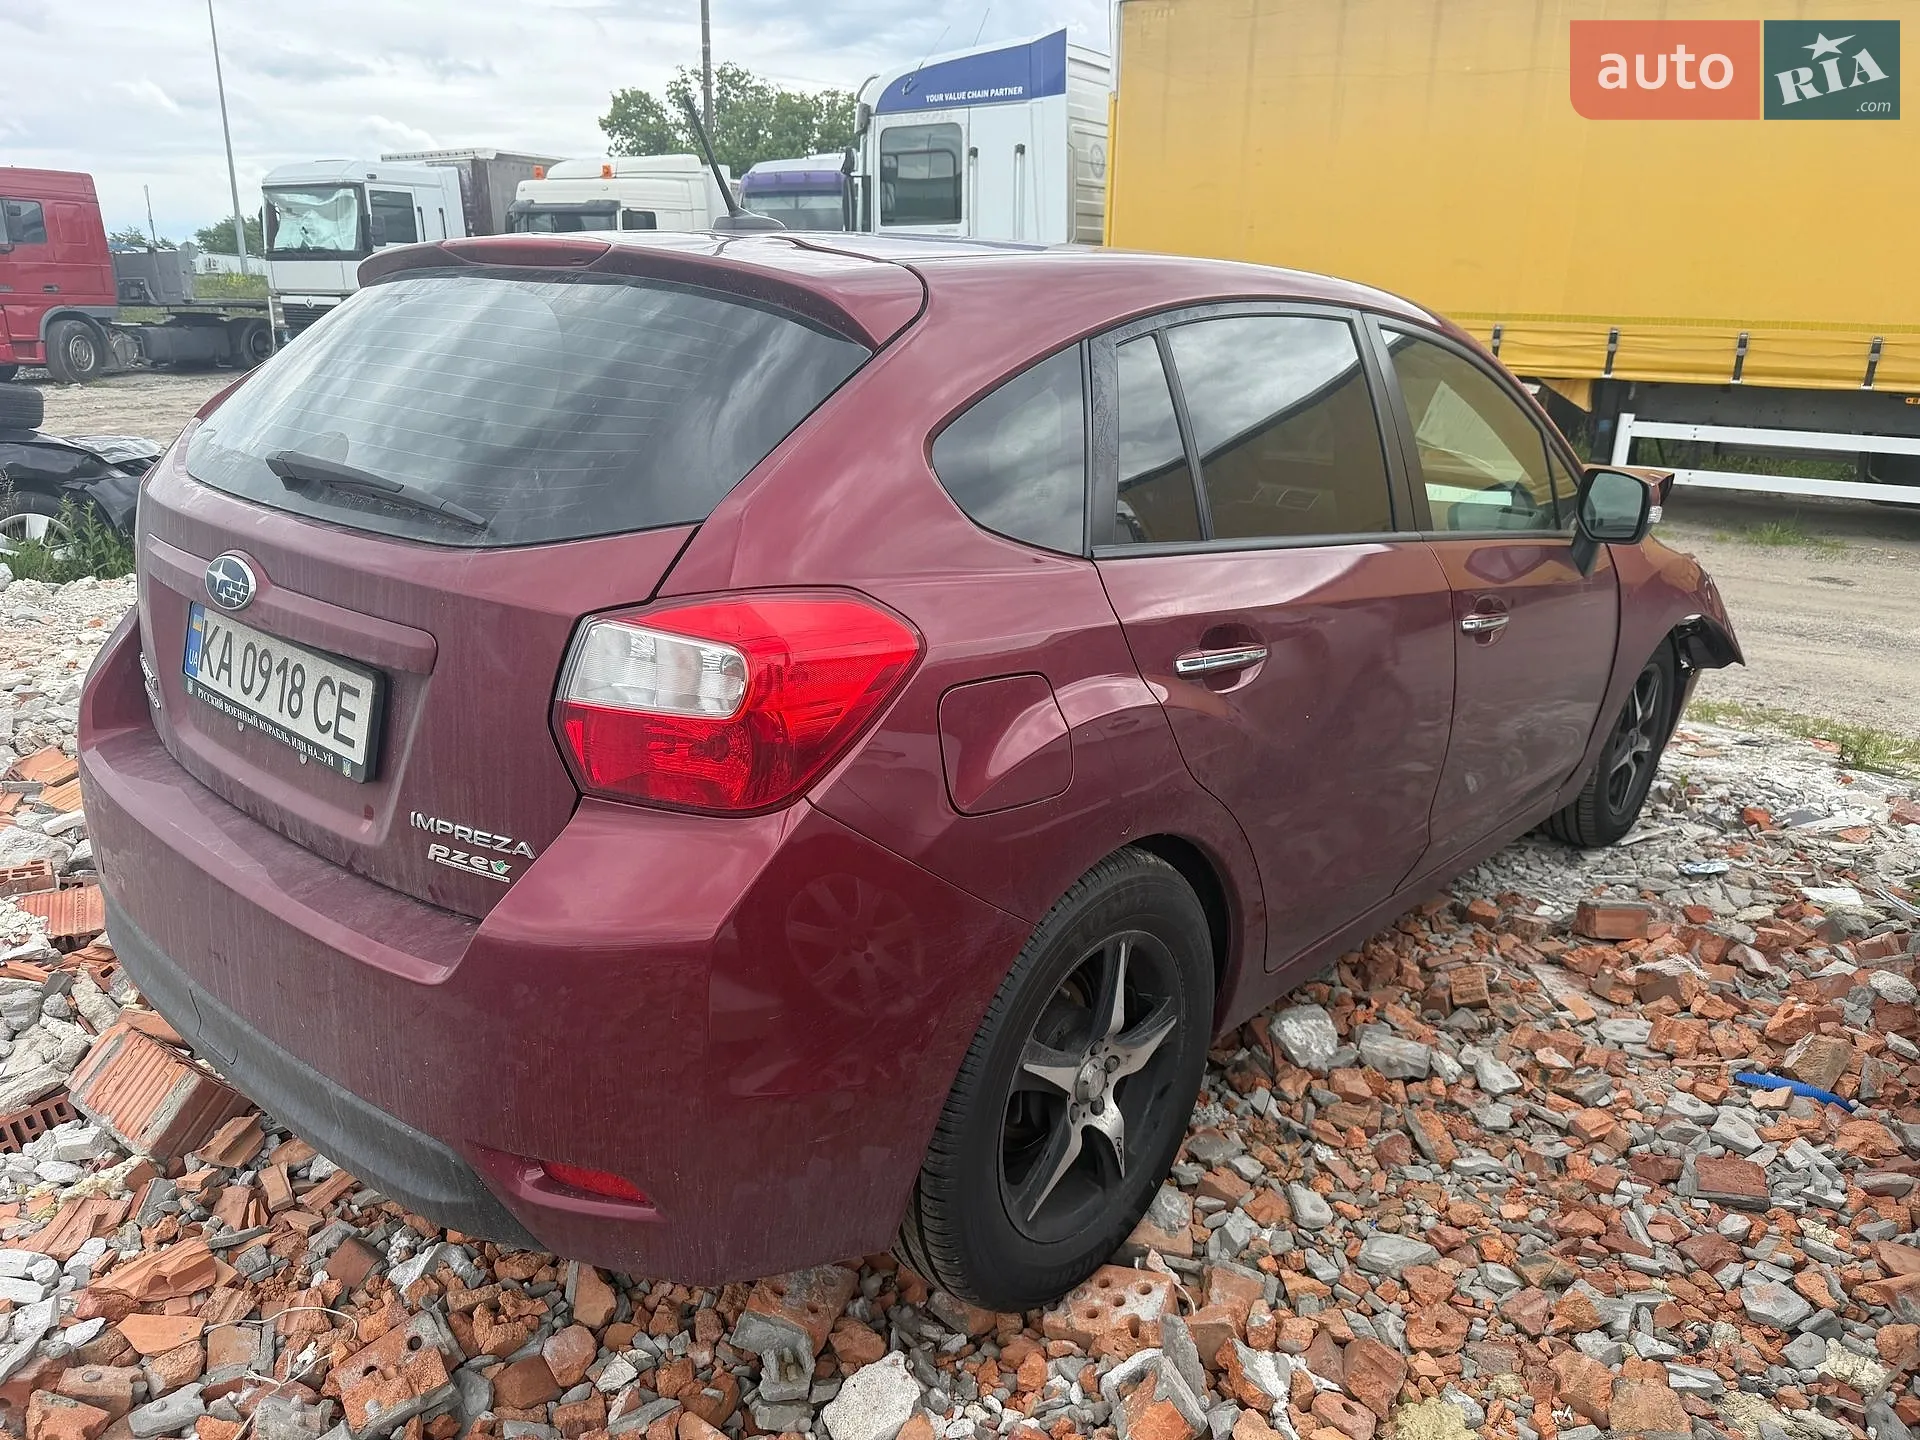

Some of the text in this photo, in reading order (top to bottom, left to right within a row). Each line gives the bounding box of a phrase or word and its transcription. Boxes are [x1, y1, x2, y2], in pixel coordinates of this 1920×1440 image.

[926, 86, 1023, 103] YOUR VALUE CHAIN PARTNER
[188, 649, 198, 668] UA
[200, 620, 233, 688] KA
[240, 642, 306, 719] 0918
[313, 675, 361, 749] CE
[197, 687, 224, 710] РУССКИЙ
[224, 702, 259, 728] ВОЕННЫЙ
[291, 735, 307, 753] ИДИ
[410, 810, 538, 861] IMPREZA
